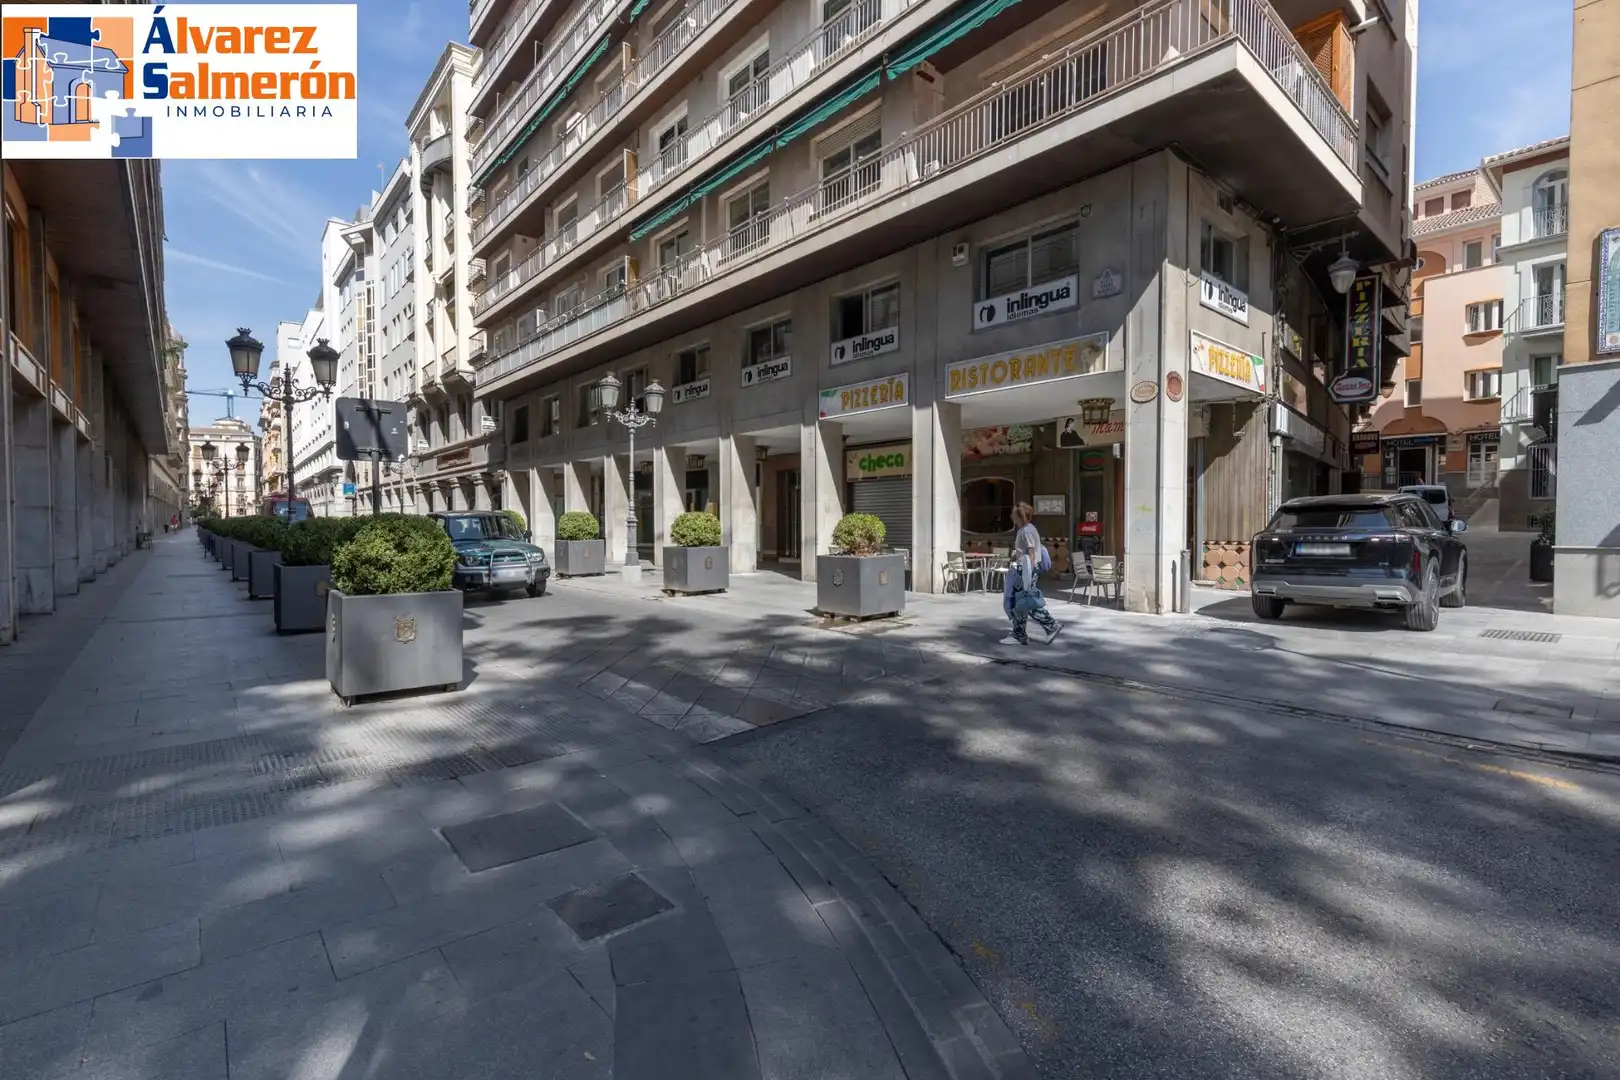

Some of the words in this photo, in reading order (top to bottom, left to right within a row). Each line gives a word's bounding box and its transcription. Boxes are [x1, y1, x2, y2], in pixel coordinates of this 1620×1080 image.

[1006, 285, 1070, 313] inlingua
[1218, 284, 1247, 313] inlingua
[1006, 307, 1039, 320] idiomas
[852, 333, 895, 353] inlingua
[757, 362, 788, 377] inlingua
[950, 343, 1078, 392] RISTORANTE
[1469, 432, 1500, 441] HOTEL
[858, 452, 904, 472] checa
